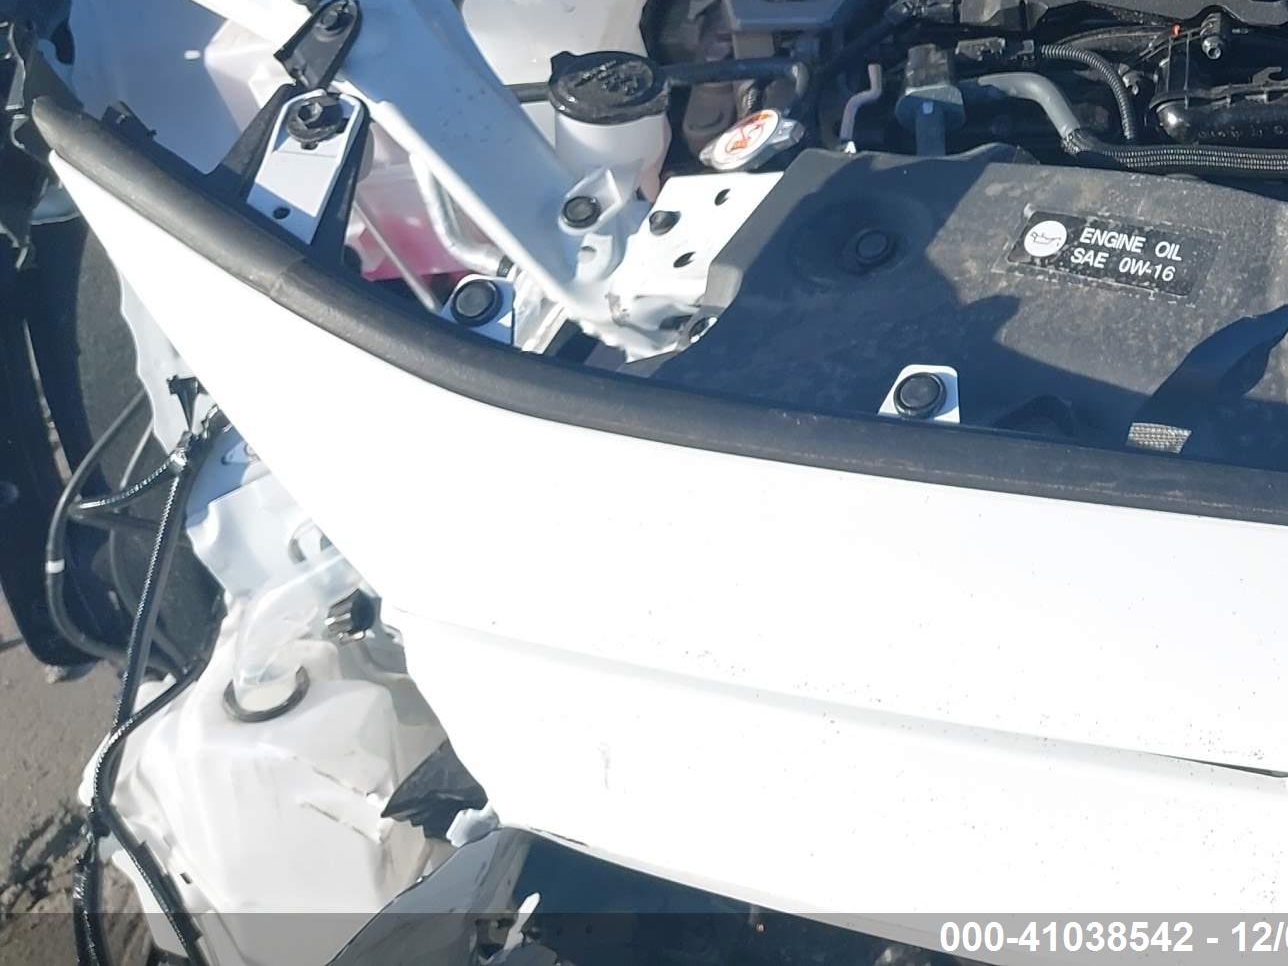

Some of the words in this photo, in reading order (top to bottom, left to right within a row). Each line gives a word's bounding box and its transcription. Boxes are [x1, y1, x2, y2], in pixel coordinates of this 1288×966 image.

[1079, 227, 1146, 253] ENGINE
[1154, 241, 1183, 262] OIL
[1070, 248, 1109, 269] SAE
[1118, 257, 1176, 282] 0W-16
